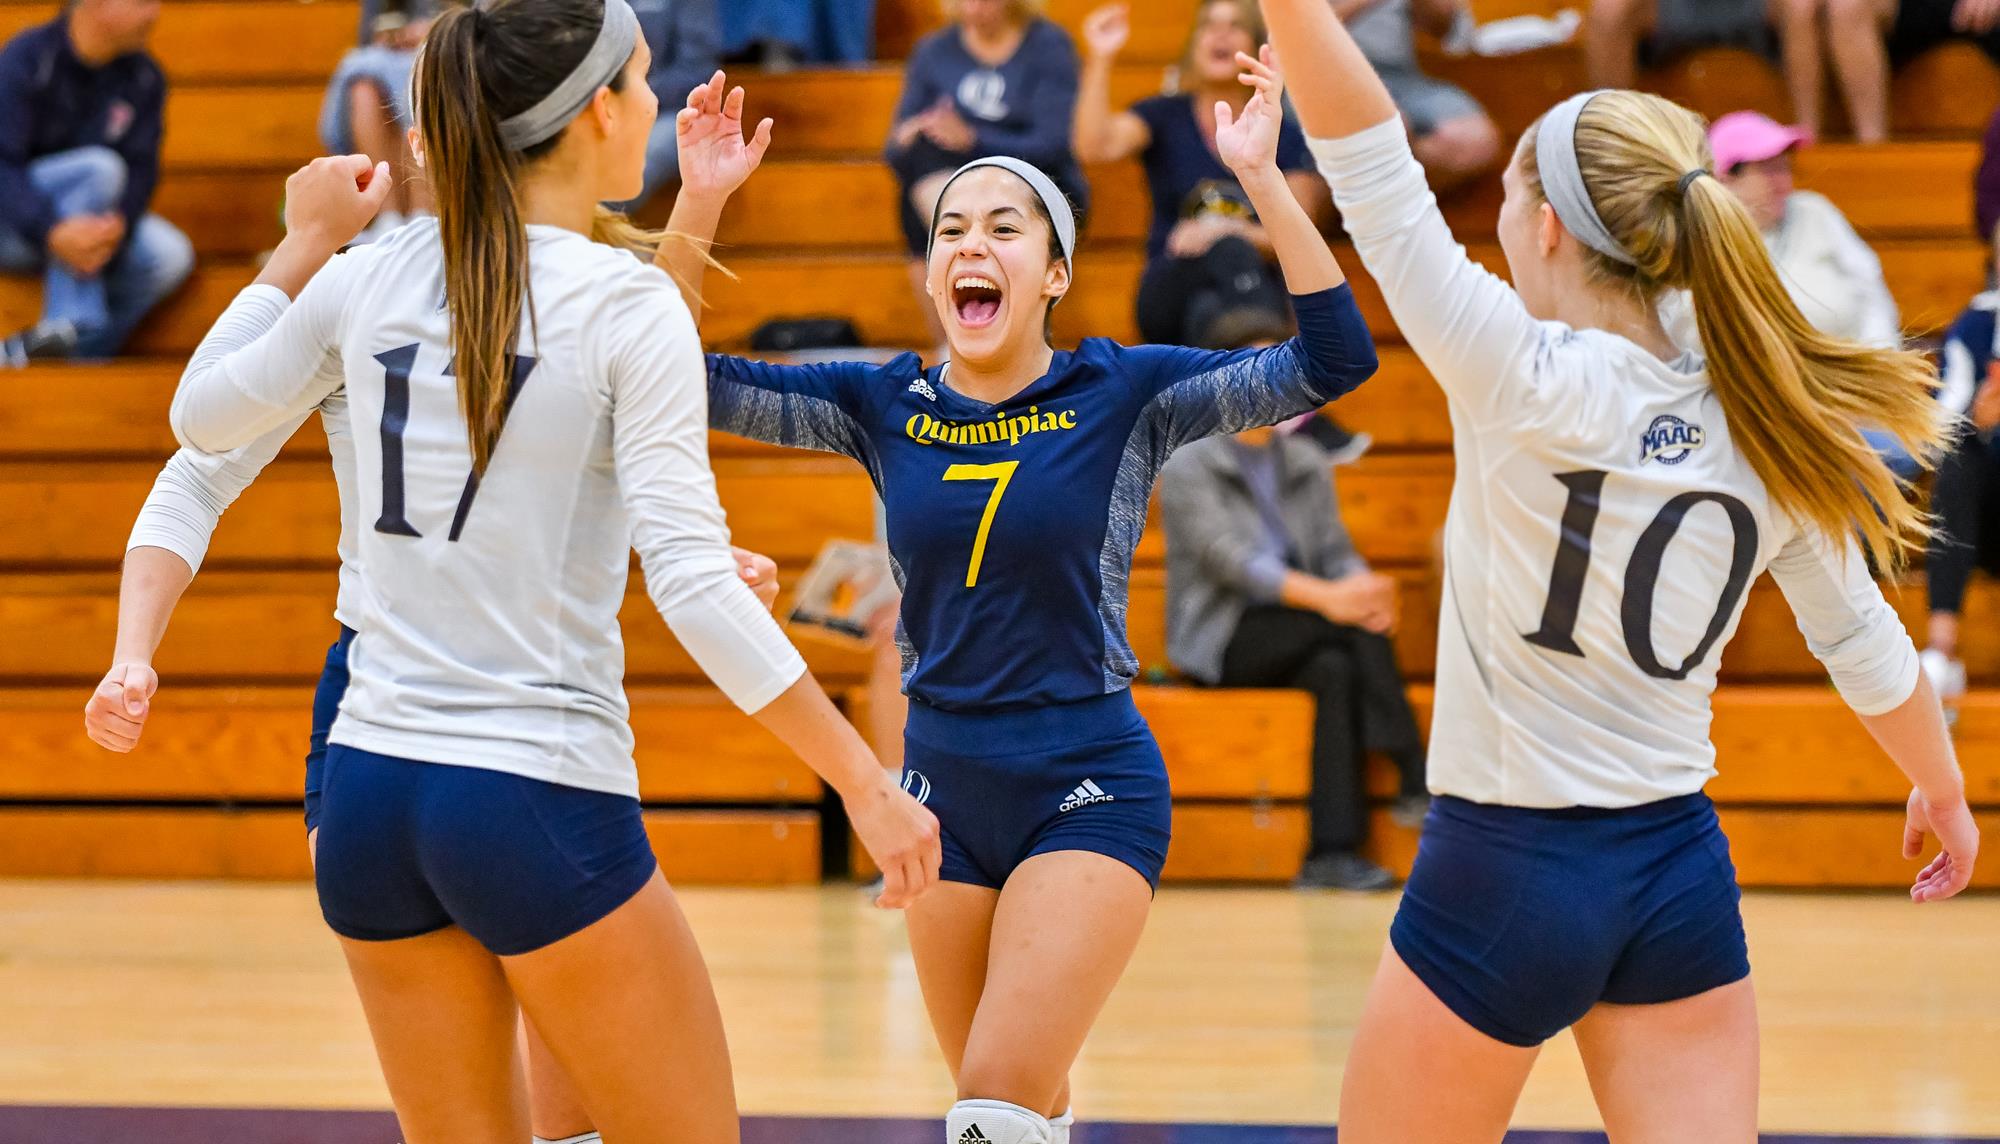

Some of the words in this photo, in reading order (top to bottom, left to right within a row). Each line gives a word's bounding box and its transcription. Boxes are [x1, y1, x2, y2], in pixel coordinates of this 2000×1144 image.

[909, 383, 937, 401] adidas
[373, 342, 538, 542] 17
[906, 405, 1077, 446] Quinnipiac
[1640, 425, 1702, 461] MAAC
[942, 460, 1020, 588] 7
[1521, 470, 1758, 681] 10
[1059, 794, 1115, 812] adidas
